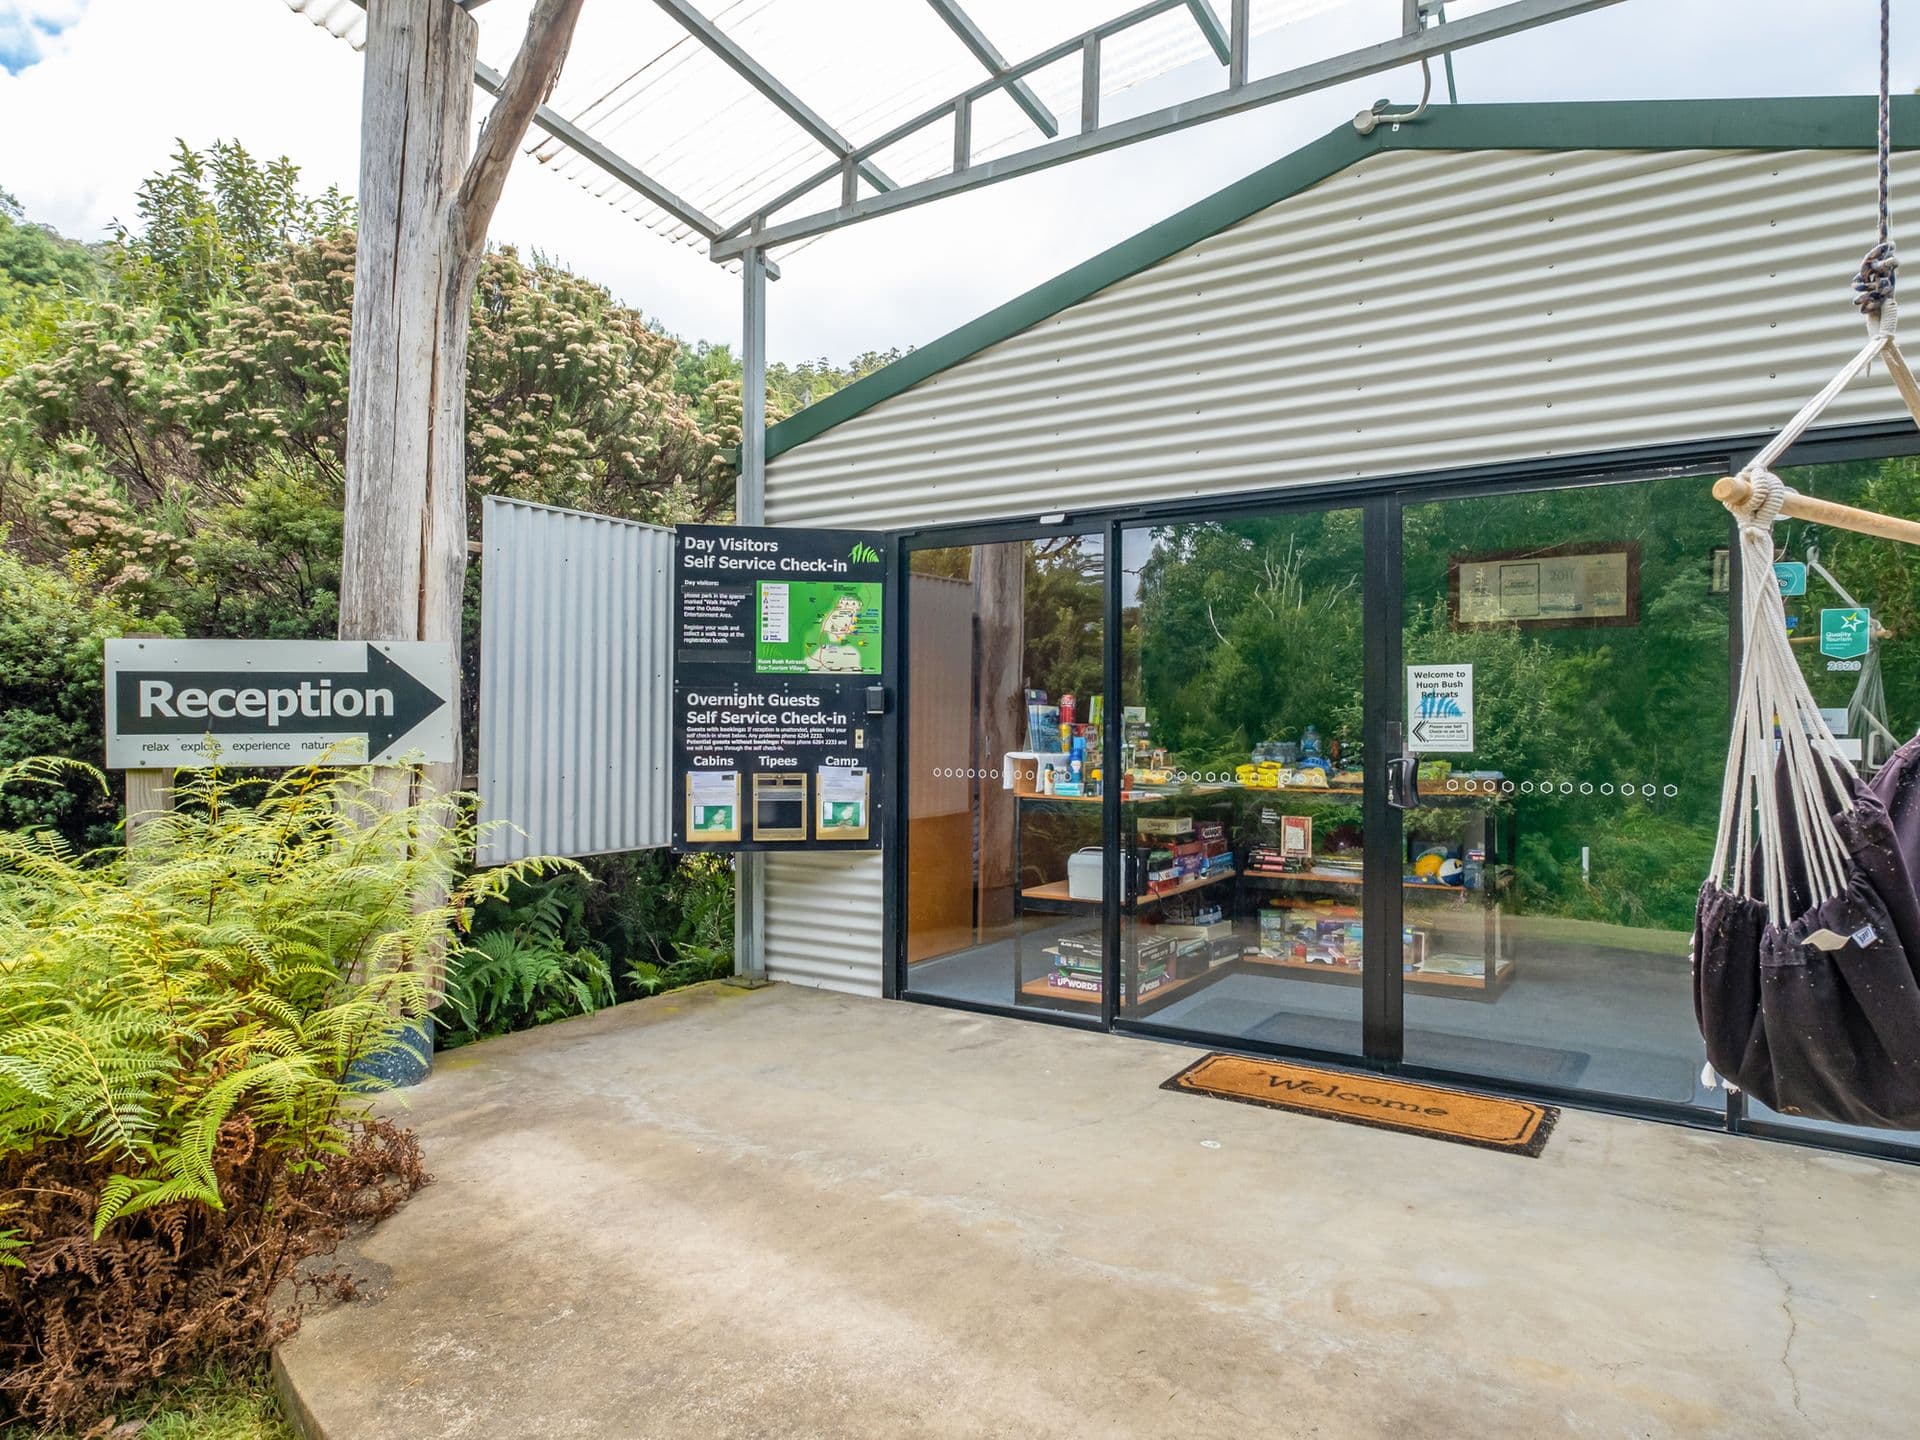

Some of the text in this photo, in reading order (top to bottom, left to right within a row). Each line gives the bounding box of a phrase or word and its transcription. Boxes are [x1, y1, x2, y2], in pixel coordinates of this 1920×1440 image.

[684, 536, 778, 553] Day Visitors
[684, 554, 848, 572] Self Service Check-in
[139, 679, 394, 727] Reception
[687, 692, 820, 708] Overnight Guests
[687, 710, 847, 724] Self Service Check-in
[142, 740, 335, 752] relax exploe experience natur
[693, 756, 734, 766] Cabins
[758, 756, 798, 768] Tipees
[825, 756, 859, 767] Camp
[1058, 978, 1098, 991] UPWORDS
[1268, 1075, 1449, 1116] Welcome
